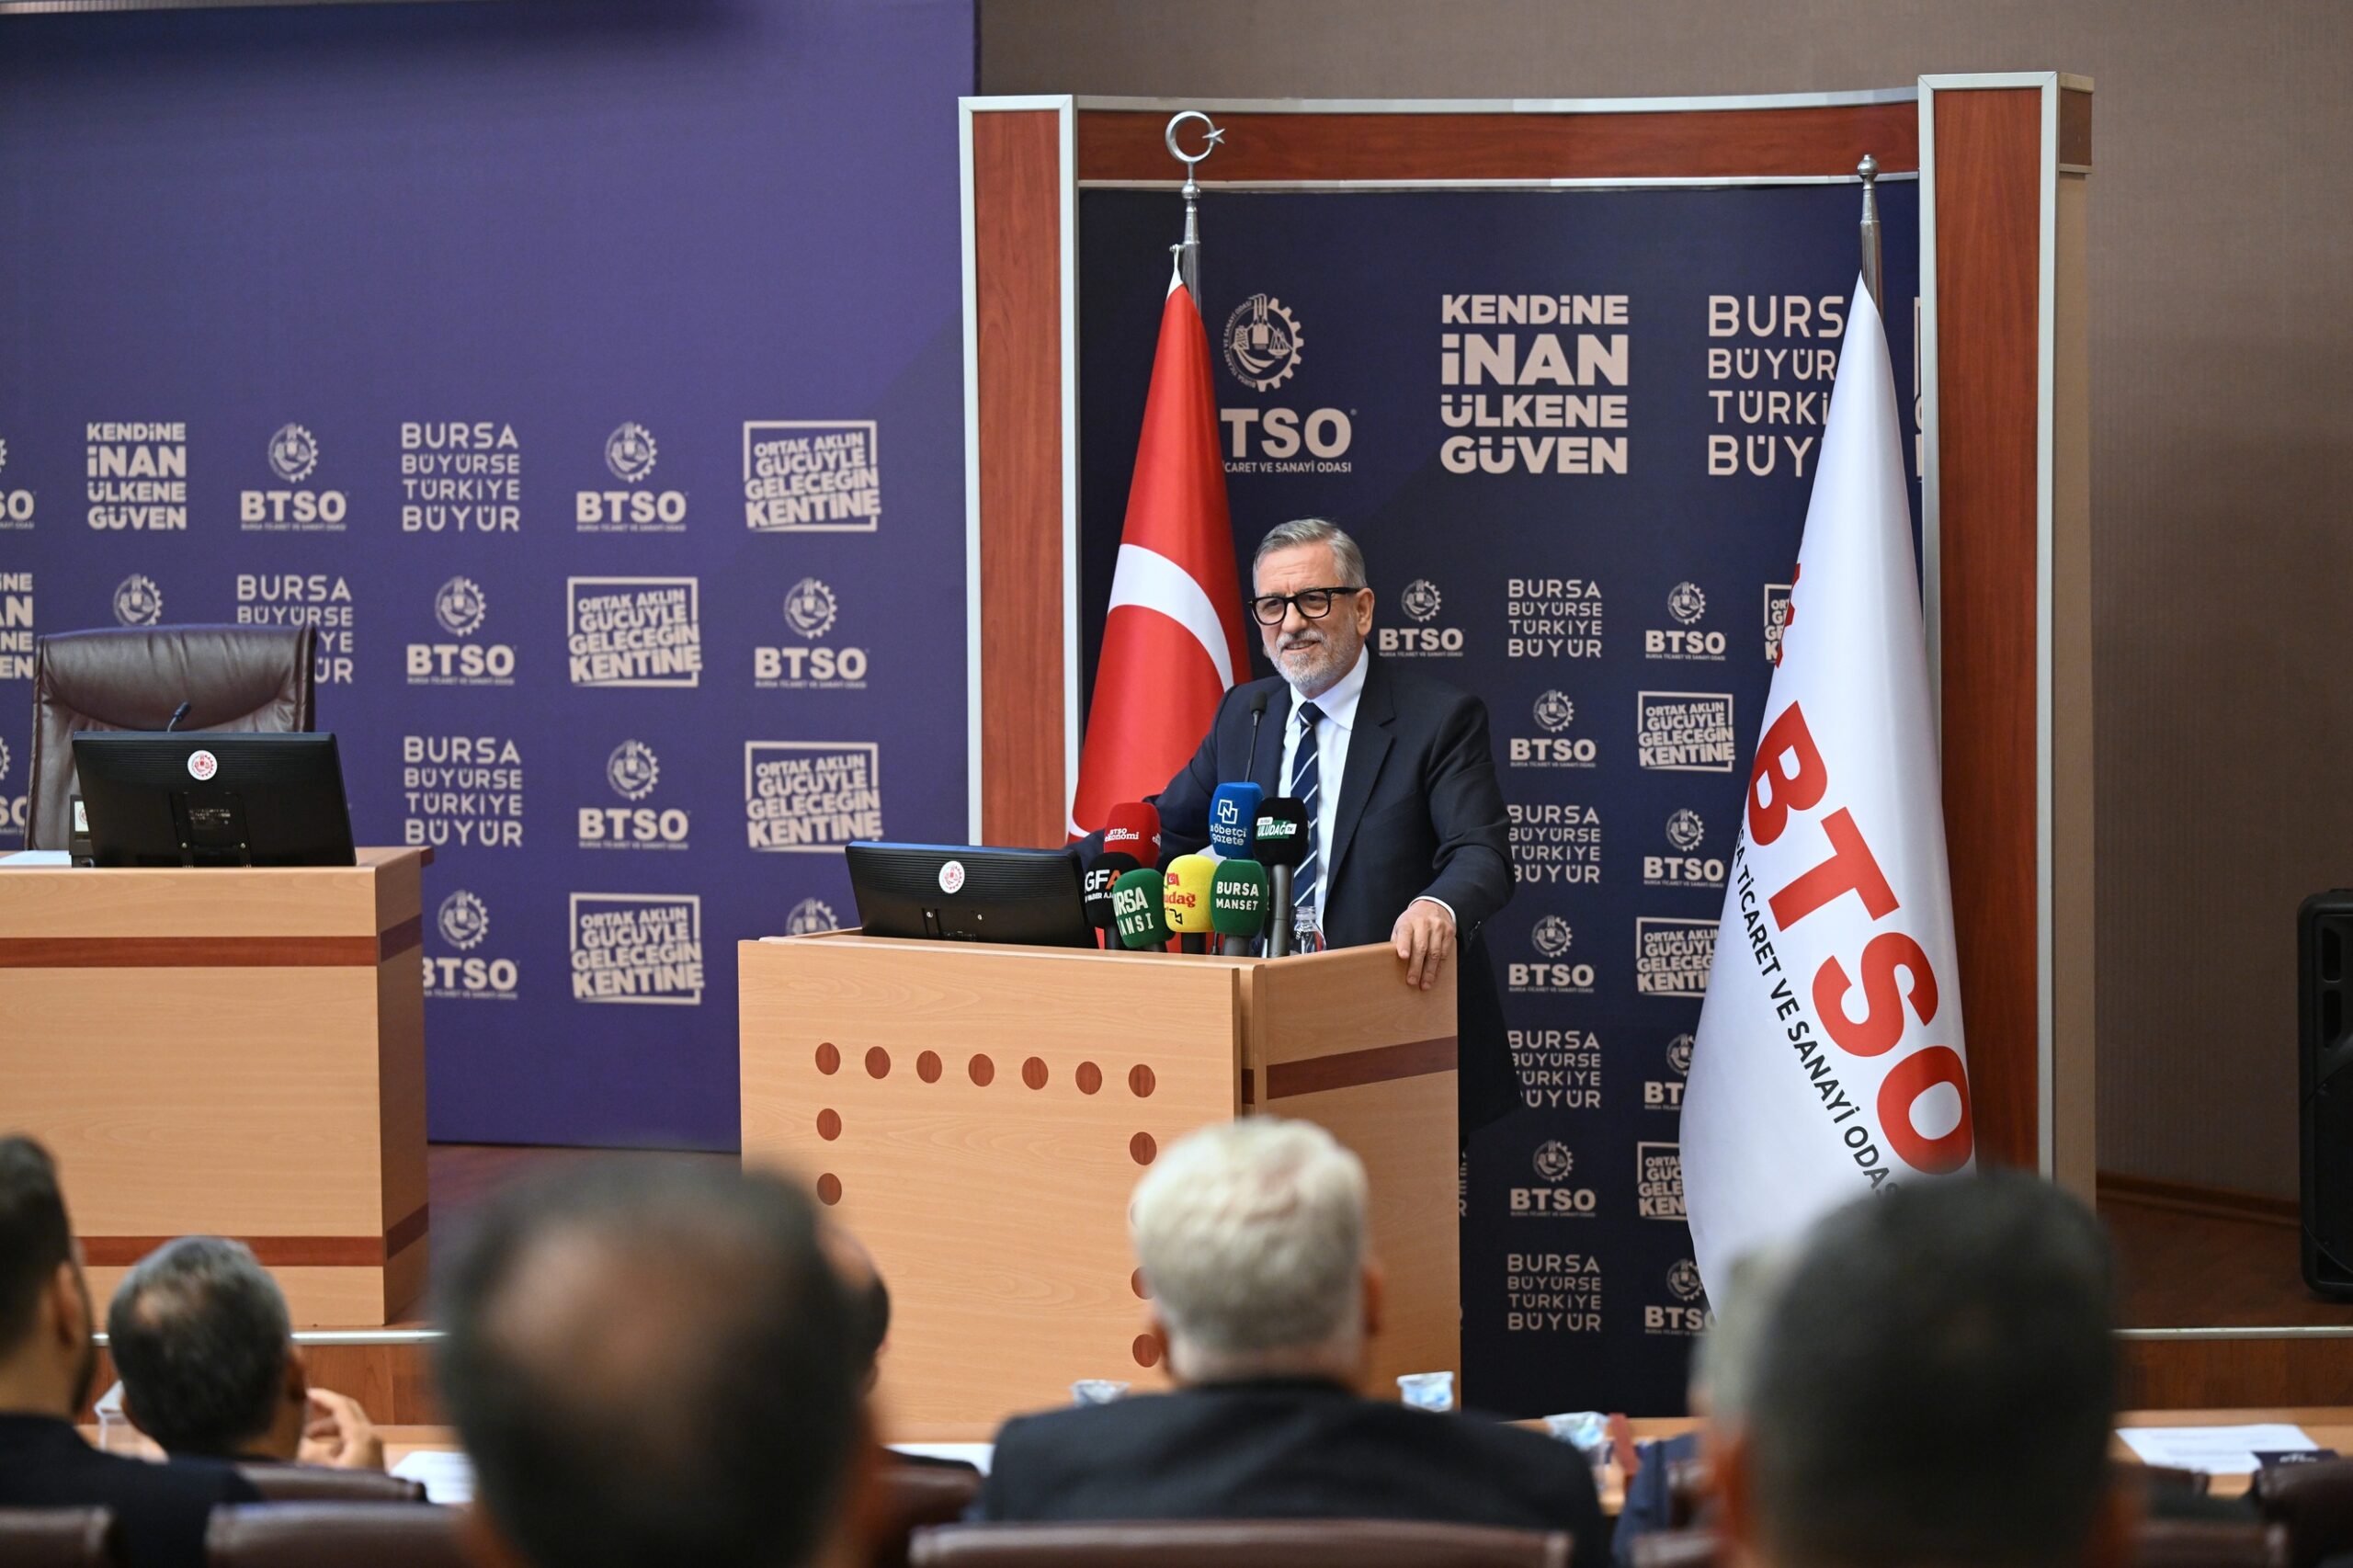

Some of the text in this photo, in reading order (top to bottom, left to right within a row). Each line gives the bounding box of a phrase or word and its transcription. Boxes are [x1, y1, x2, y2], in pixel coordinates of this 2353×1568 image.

[1708, 295, 1844, 337] BURS
[1708, 347, 1836, 381] BÜYÜR
[1440, 394, 1628, 427] ÜLKENE
[1708, 391, 1828, 425] TÜRKİ
[402, 422, 518, 449] BURSA
[754, 431, 864, 458] ORTAK AKLIN
[1221, 407, 1352, 459] TSO
[402, 454, 520, 474] BÜYÜRSE
[1223, 460, 1352, 472] CARET VE SANAYİ ODASI
[1440, 436, 1628, 474] GÜVEN
[1708, 435, 1824, 477] BÜY
[87, 482, 187, 503] ÜLKENE
[87, 506, 188, 530] GÜVEN
[241, 490, 347, 522] BTSO
[576, 491, 687, 523] BTSO
[403, 506, 520, 531] BÜYÜR
[237, 574, 352, 600] BURSA
[1508, 579, 1601, 598] BURSA
[578, 588, 685, 613] ORTAK AKLIN
[1508, 601, 1602, 617] BÜYÜRSE
[237, 607, 353, 626] BÜYÜRSE
[1379, 628, 1463, 652] BTSO
[1508, 639, 1602, 658] BÜYÜR
[1645, 630, 1726, 654] BTSO
[406, 643, 515, 676] BTSO
[754, 647, 867, 679] BTSO
[1645, 701, 1724, 717] ORTAK AKLIN
[404, 735, 521, 765] BURSA
[1510, 738, 1597, 762] BTSO
[756, 754, 866, 778] ORTAK AKLIN
[404, 767, 523, 790] BÜYÜRSE
[578, 808, 689, 840] BTSO
[1507, 804, 1600, 824] BURSA
[405, 818, 523, 846] BÜYÜR
[1105, 832, 1140, 842] ekonomi
[1212, 833, 1245, 846] gazete
[1257, 821, 1287, 837] ULUDAĞ
[1086, 869, 1121, 892] GFA
[1643, 857, 1724, 881] BTSO
[1164, 891, 1196, 908] udağ
[1216, 881, 1259, 897] BURSA
[1114, 887, 1148, 916] URSA
[580, 906, 688, 929] ORTAK AKLIN
[1118, 913, 1154, 937] ANSI
[1643, 930, 1684, 943] ORTAK
[1748, 700, 1973, 1176] BTSO
[1508, 963, 1595, 987] BTSO
[1637, 970, 1710, 992] KENTİ
[1507, 1030, 1599, 1050] BURSA
[1737, 864, 1897, 1194] TİCARET VE SANAYİ ODA
[1517, 1071, 1601, 1086] ÜRKİYE
[1521, 1089, 1600, 1108] ÜYÜR
[1644, 1081, 1684, 1104] BT
[1510, 1188, 1596, 1211] BTSO
[1507, 1254, 1600, 1273] BURSA
[1507, 1276, 1601, 1291] BÜYÜRSE
[1508, 1312, 1601, 1332] BÜYÜR
